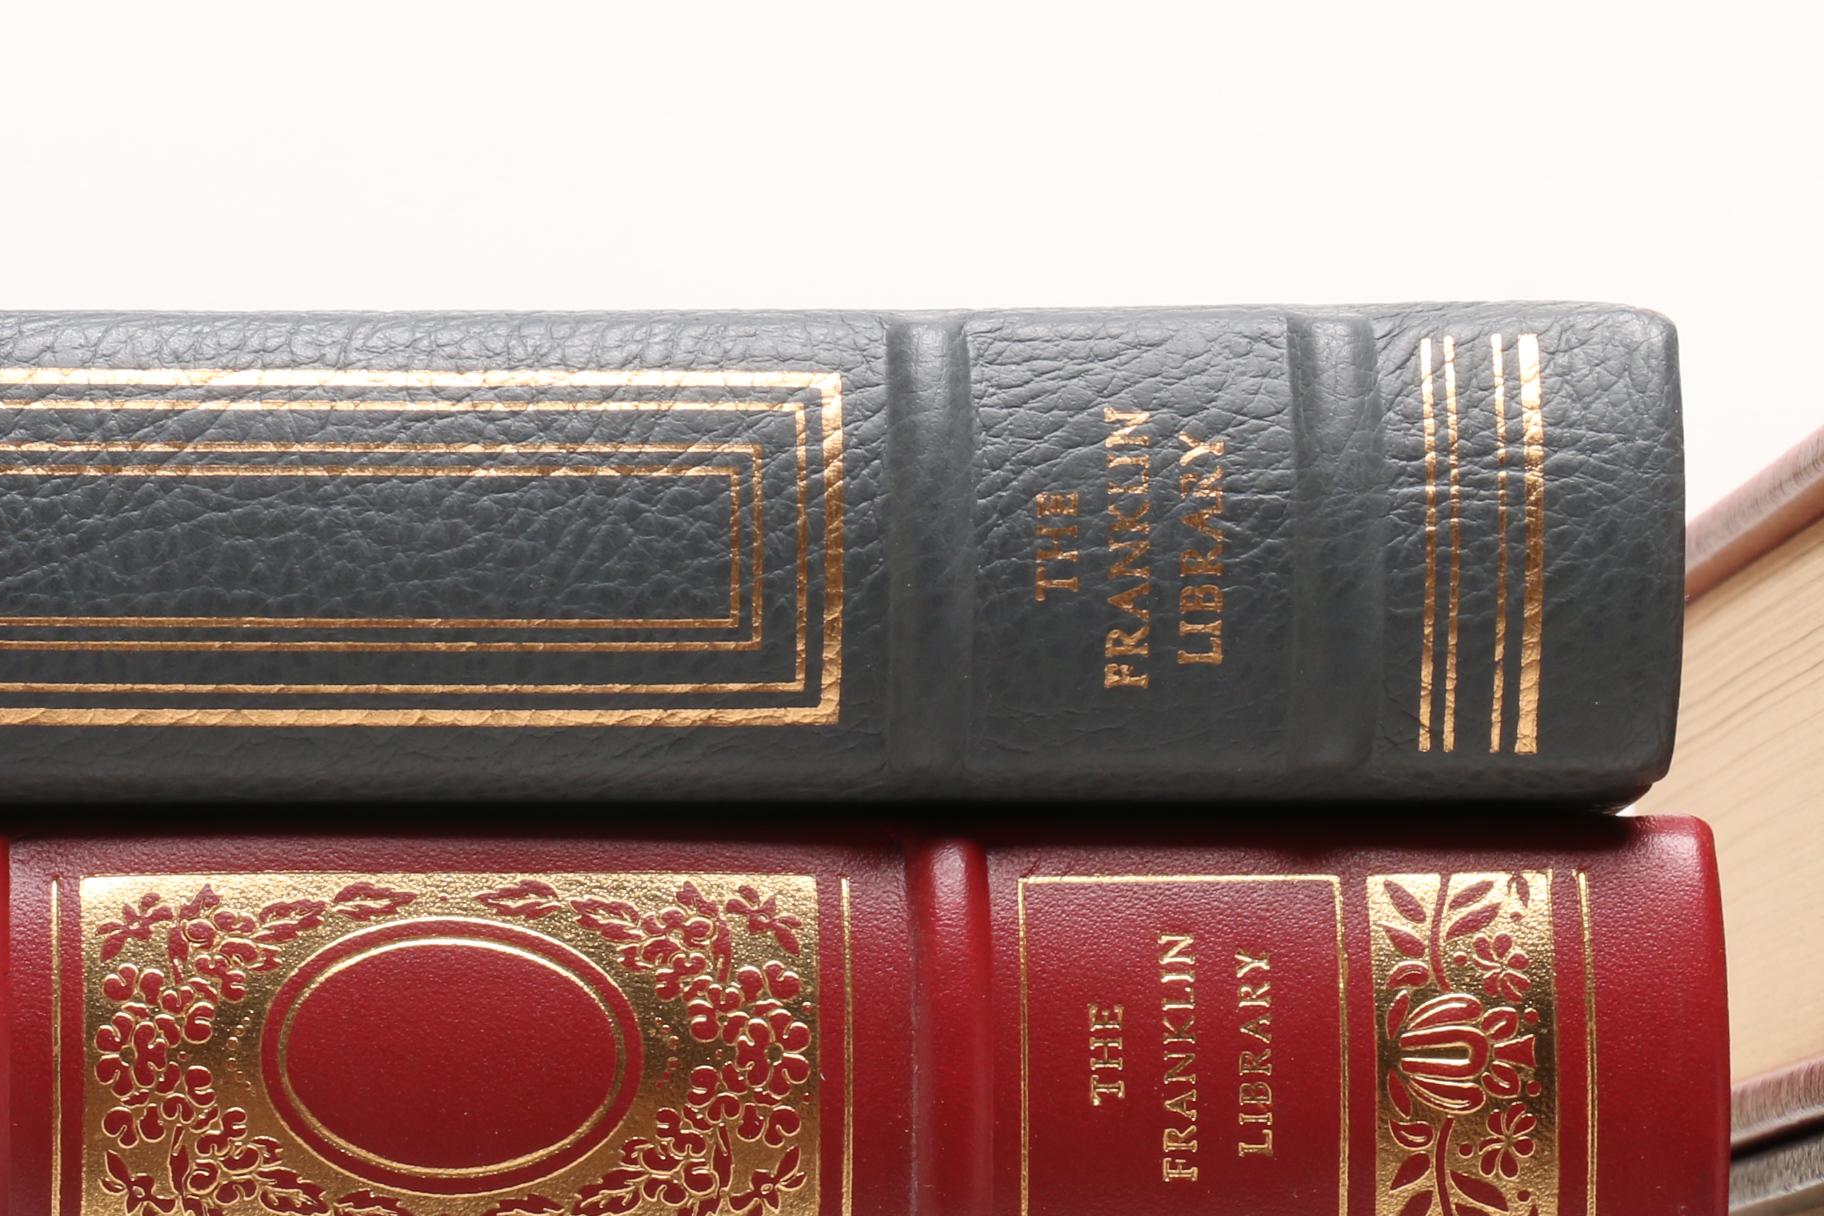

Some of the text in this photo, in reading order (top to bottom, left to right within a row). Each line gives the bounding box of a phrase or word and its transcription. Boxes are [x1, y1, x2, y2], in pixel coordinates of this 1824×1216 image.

[1034, 491, 1080, 603] THE
[1104, 406, 1151, 689] FRANKLIN
[1177, 431, 1225, 665] LIBRARY
[1088, 1003, 1125, 1106] THE
[1157, 932, 1198, 1182] FRANKLIN
[1234, 949, 1273, 1157] LIBRARY
